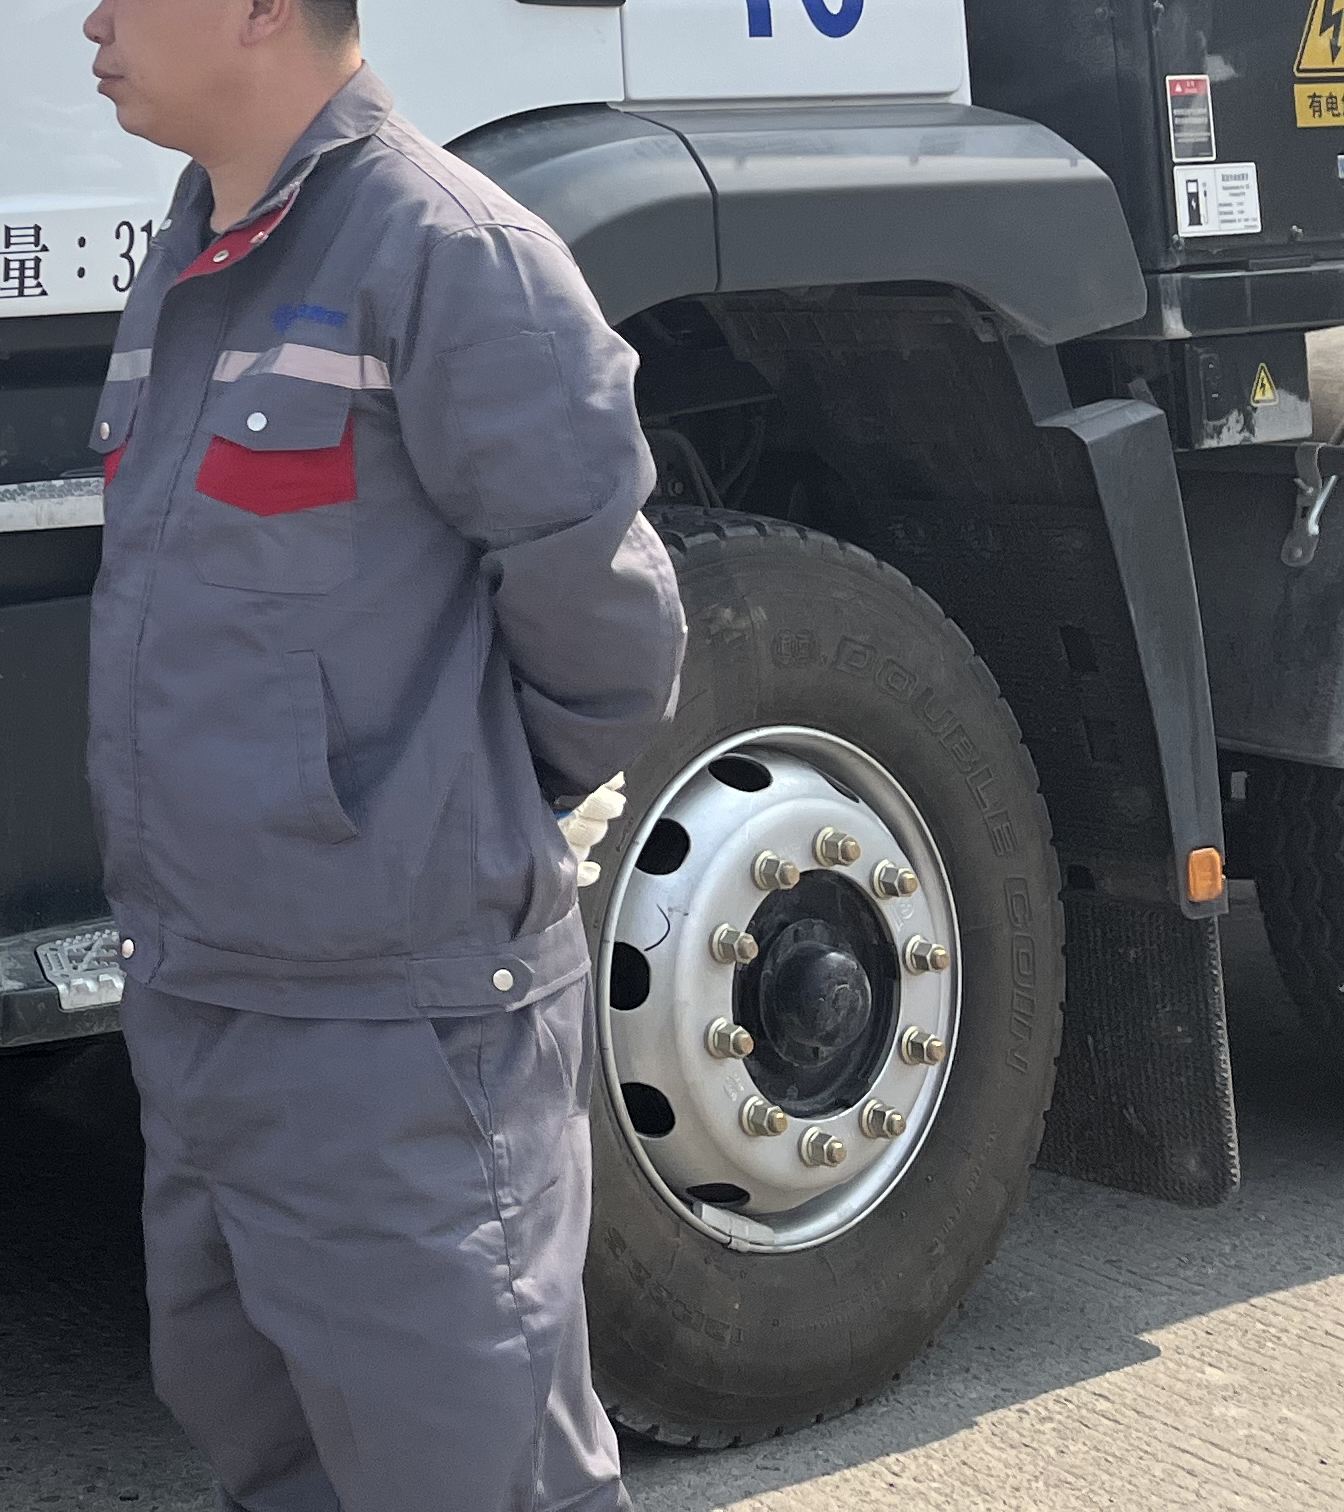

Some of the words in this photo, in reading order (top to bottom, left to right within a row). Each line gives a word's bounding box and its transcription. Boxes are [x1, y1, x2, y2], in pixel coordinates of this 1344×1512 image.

[1306, 91, 1344, 121] 有电
[835, 635, 1018, 858] DOUBLE
[1003, 876, 1036, 1075] COIN
